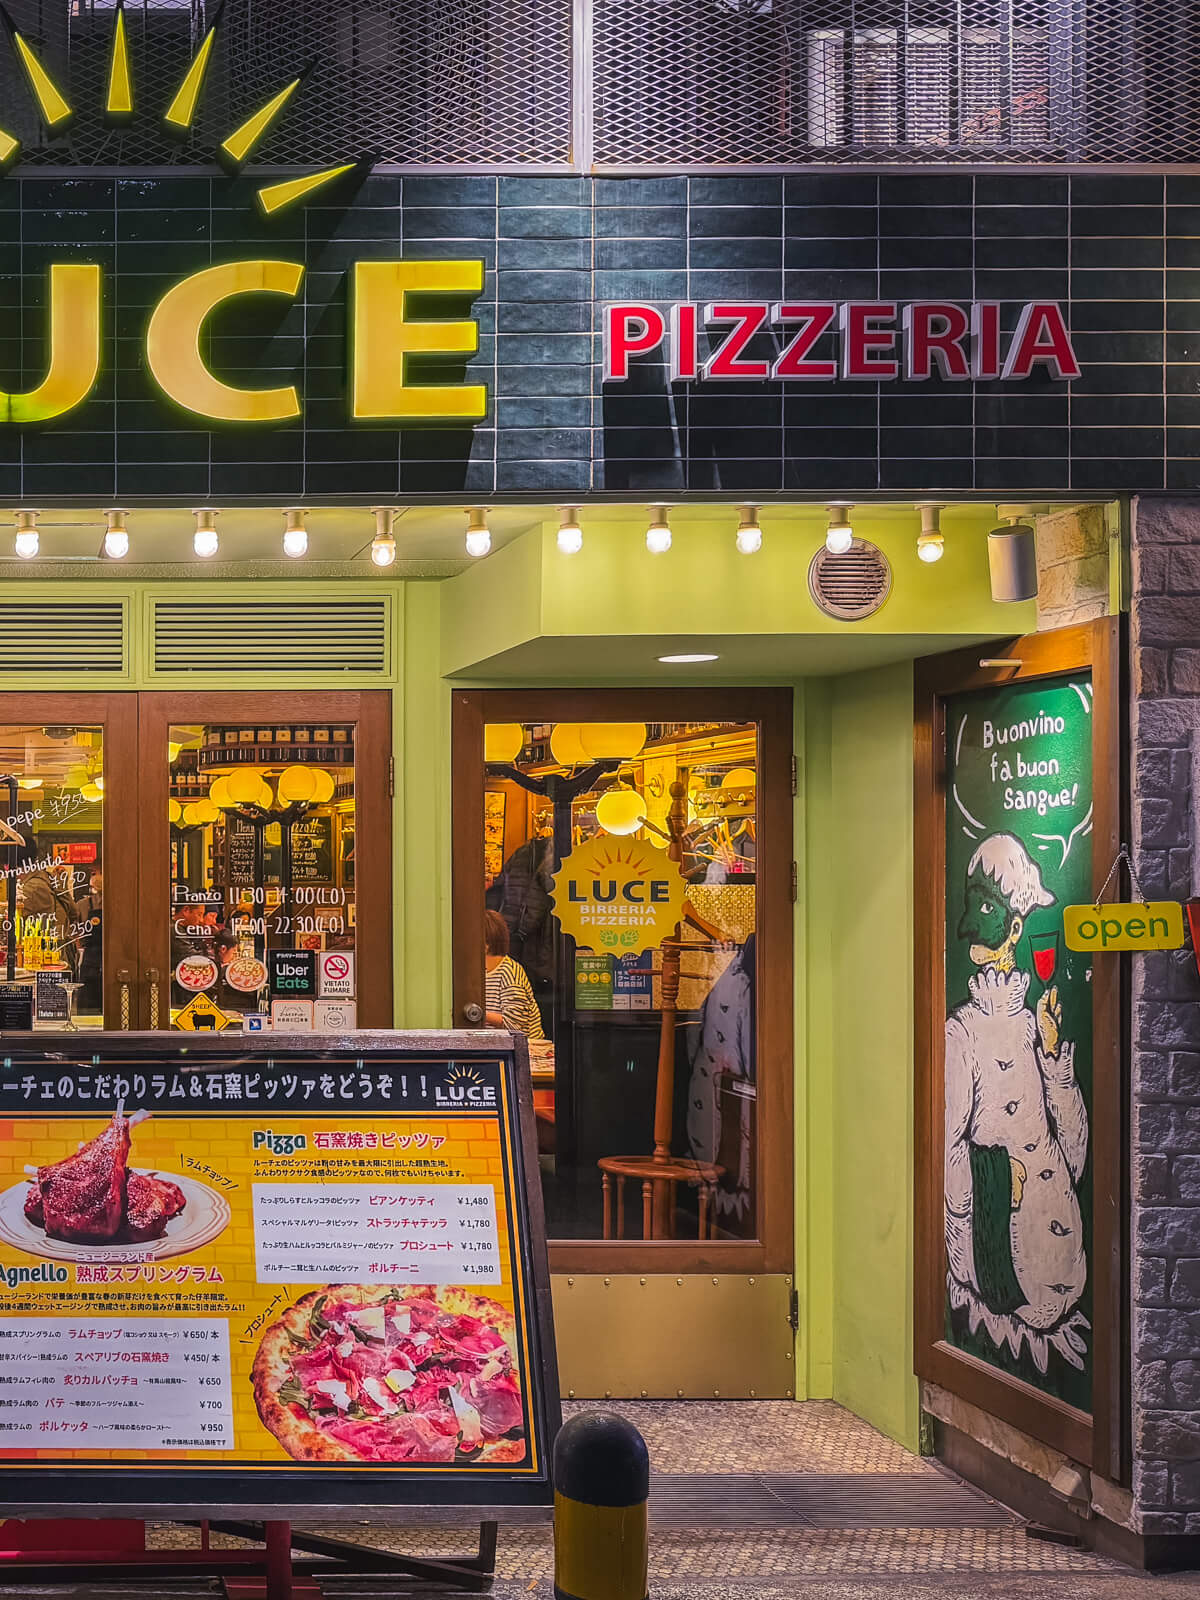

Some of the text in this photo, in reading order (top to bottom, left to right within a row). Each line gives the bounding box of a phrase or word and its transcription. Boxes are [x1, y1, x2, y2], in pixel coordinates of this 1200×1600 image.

[603, 303, 1081, 381] PIZZERIA
[1016, 752, 1060, 778] buon
[6, 808, 46, 828] pepe
[174, 885, 222, 902] Pranzo
[568, 880, 670, 903] LUCE
[580, 905, 657, 915] BIRRERIA
[174, 918, 212, 936] Cena
[580, 916, 657, 926] PIZZERIA
[1076, 916, 1169, 940] open
[276, 963, 309, 976] Uber
[276, 977, 310, 989] Eats
[435, 1086, 497, 1101] LUCE
[253, 1130, 447, 1155] Pizza 石窯焼きピッツァ
[457, 1197, 489, 1206] ¥1,480
[366, 1217, 448, 1229] ストラッチャテッラ
[459, 1219, 490, 1228] ¥1,780
[400, 1240, 454, 1251] プロシュート
[460, 1241, 492, 1251] ¥1,780
[76, 1252, 155, 1263] ニュージーランド産
[76, 1265, 224, 1284] 熟成スプリングラム
[368, 1262, 420, 1273] ポルチーニ
[462, 1264, 494, 1274] ¥1,980
[67, 1328, 122, 1339] ラムチョップ
[74, 1351, 170, 1363] スペアリブの石窯焼き
[63, 1374, 138, 1386] 炙りカルパッチョ
[198, 1376, 221, 1386] ¥650
[45, 1397, 65, 1409] パテ
[199, 1400, 223, 1410] ¥700
[38, 1420, 89, 1432] ポルケッタ
[199, 1423, 224, 1433] ¥950
